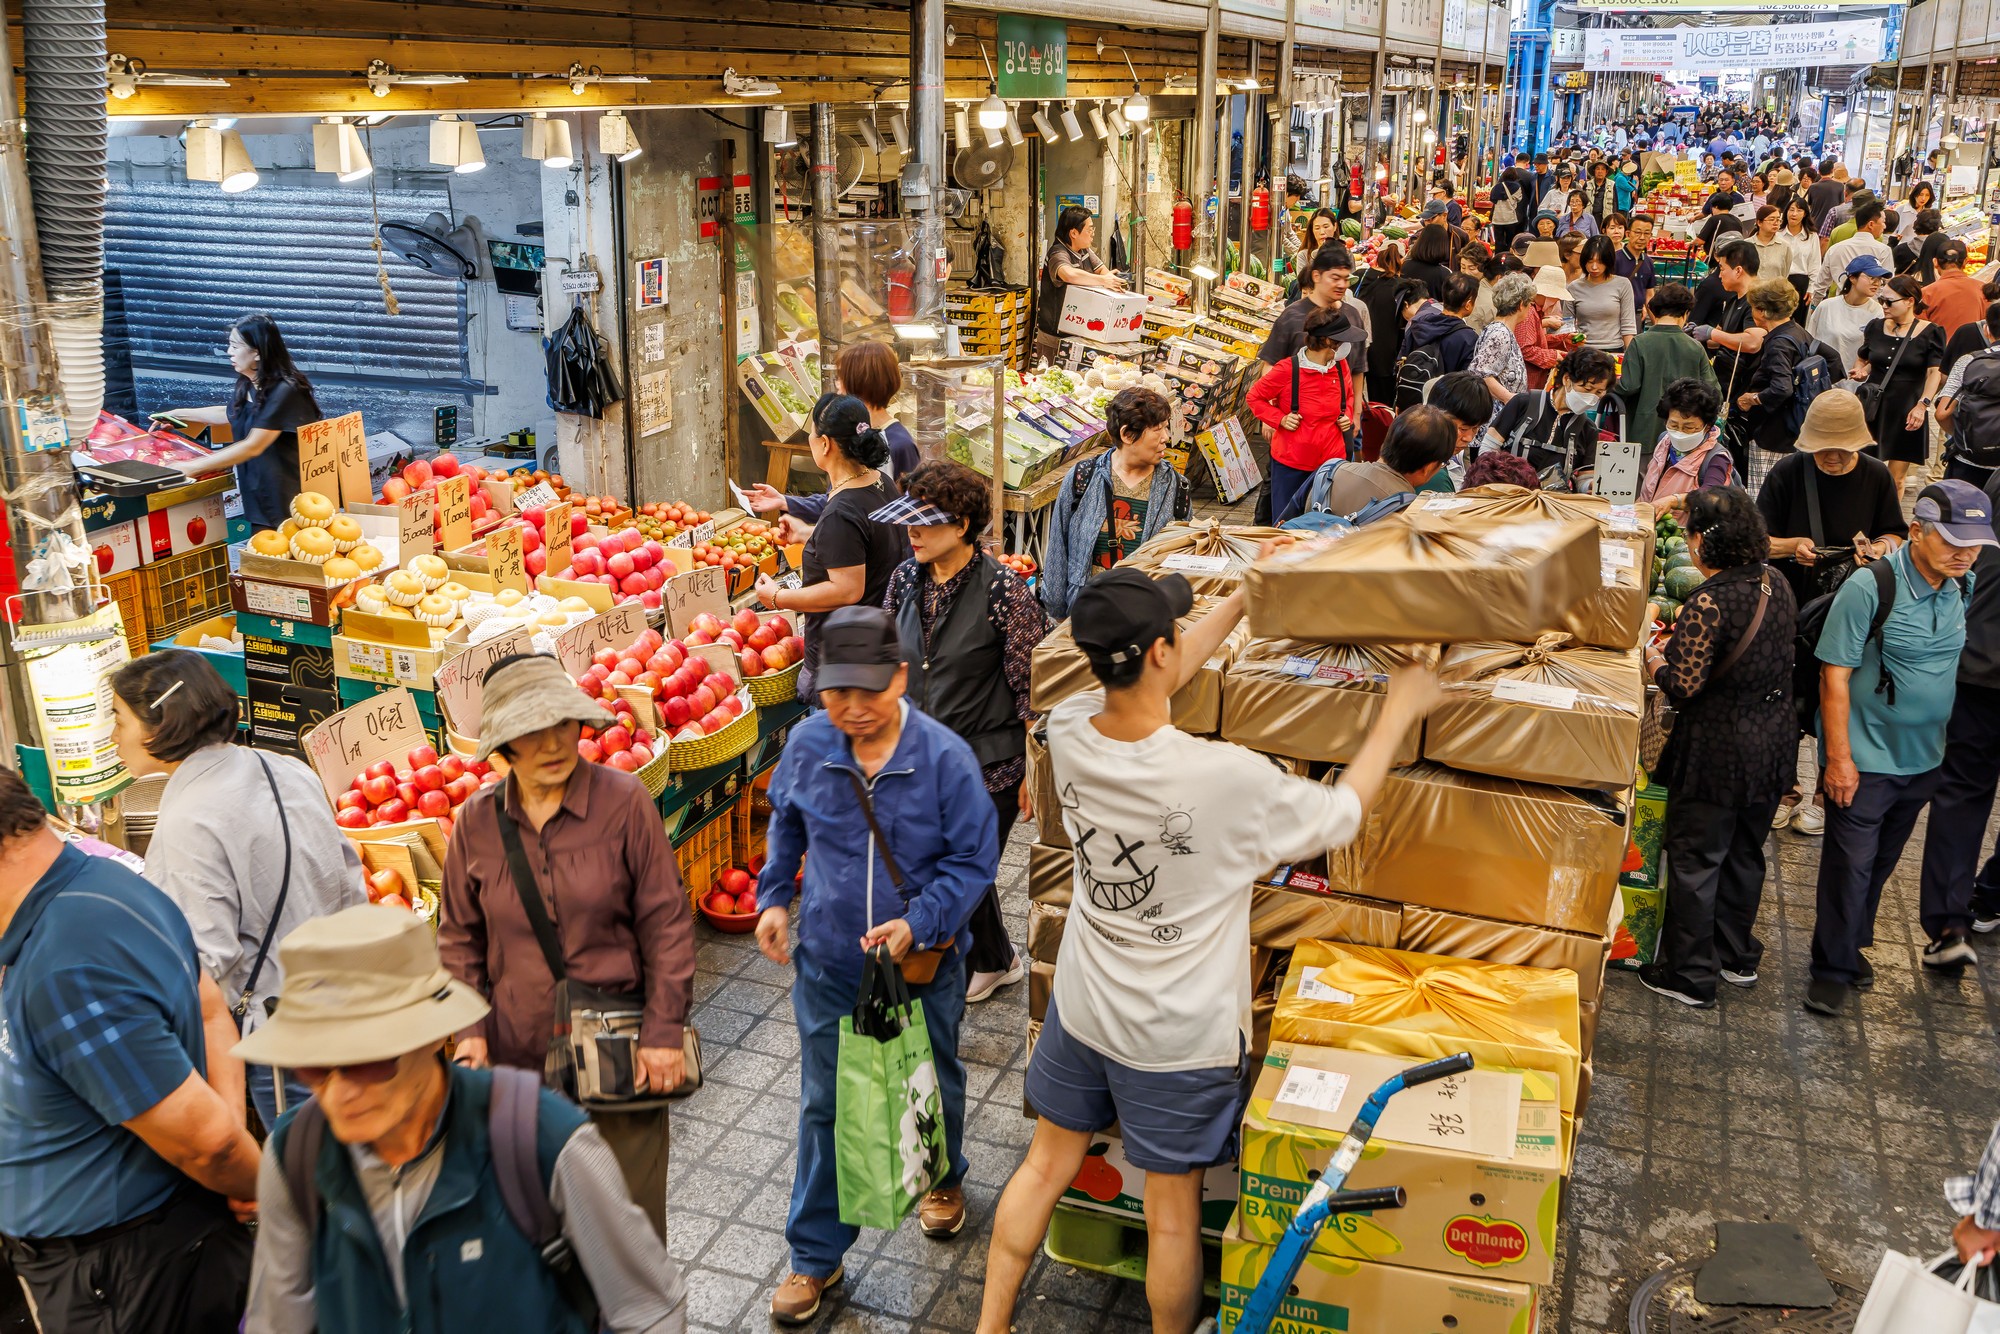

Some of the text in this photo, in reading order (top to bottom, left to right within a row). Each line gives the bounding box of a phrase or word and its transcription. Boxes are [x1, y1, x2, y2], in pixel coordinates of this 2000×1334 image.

[1004, 41, 1063, 76] 강오 상회
[701, 196, 719, 217] CCT
[1065, 313, 1085, 325] 사과
[1113, 317, 1129, 329] 사과
[1599, 443, 1636, 459] 오이
[597, 610, 634, 643] 만원
[365, 702, 406, 742] 만원
[328, 716, 362, 766] 7개
[1629, 871, 1648, 880] 20kg
[1246, 1175, 1308, 1202] Premi
[1451, 1227, 1522, 1250] Del Monte
[1226, 1286, 1319, 1322] Prium
